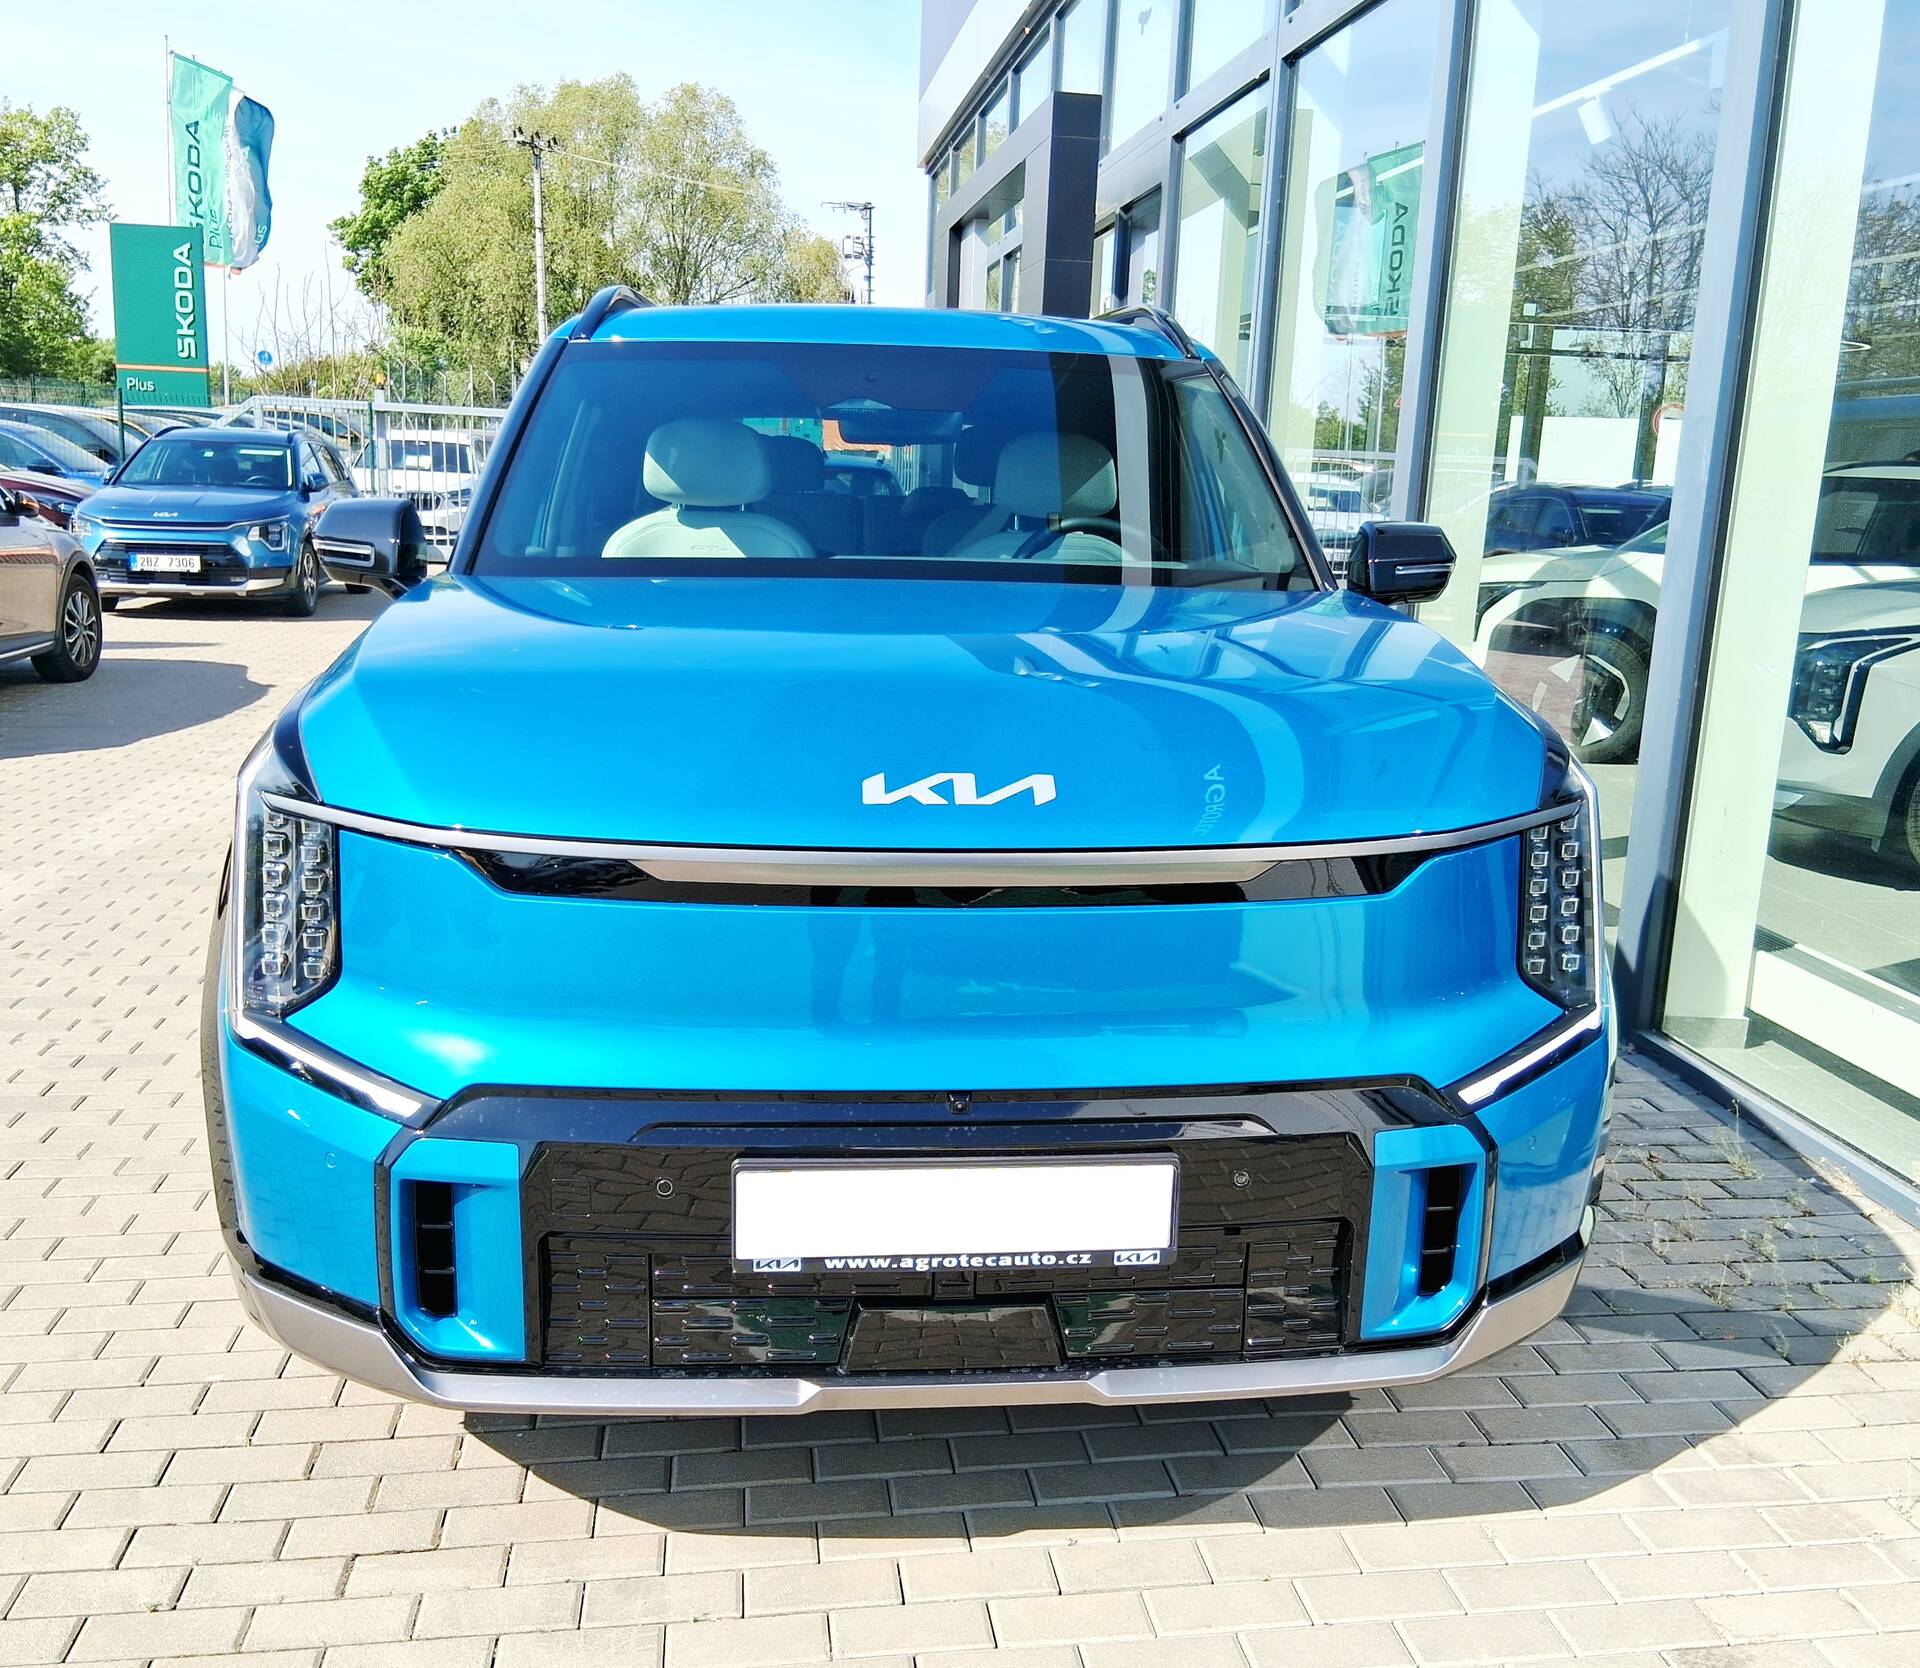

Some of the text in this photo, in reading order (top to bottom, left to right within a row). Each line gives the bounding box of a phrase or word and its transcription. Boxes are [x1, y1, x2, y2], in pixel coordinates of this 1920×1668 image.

[127, 377, 155, 391] Plus
[140, 557, 195, 568] 2BZ 7306
[862, 772, 1056, 806] KIA
[755, 1252, 1157, 1271] KIA www.agrotecauto.cz KIA
